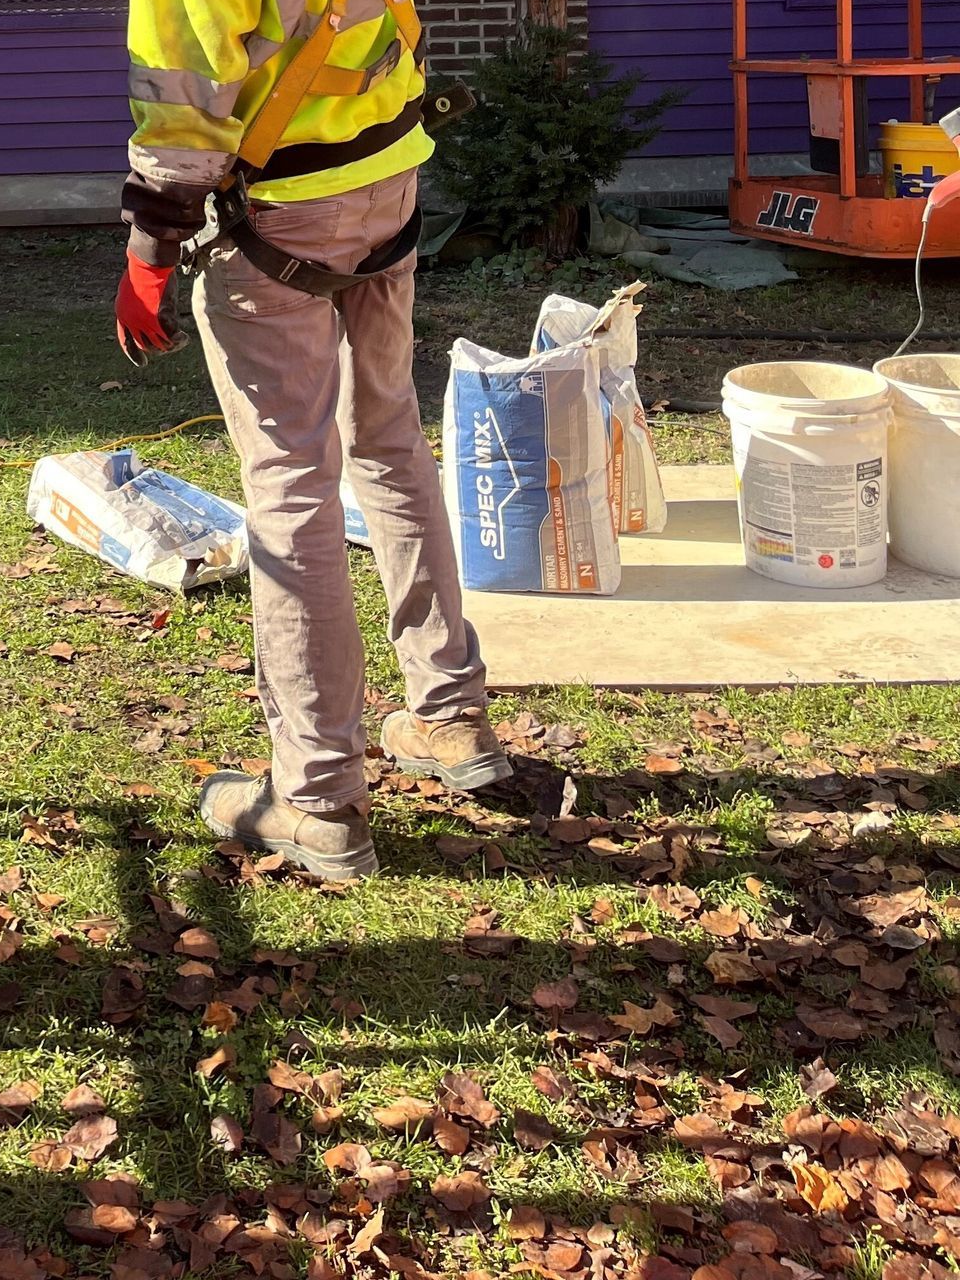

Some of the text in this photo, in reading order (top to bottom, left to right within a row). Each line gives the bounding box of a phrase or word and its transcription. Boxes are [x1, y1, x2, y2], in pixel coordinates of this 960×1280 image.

[756, 191, 820, 235] JLG
[477, 474, 498, 548] SPEC
[553, 496, 563, 516] SAND
[630, 510, 642, 521] N
[555, 526, 567, 556] CEMENT
[545, 554, 557, 589] MORTAR
[558, 556, 569, 589] MASONRY
[580, 565, 593, 577] N
